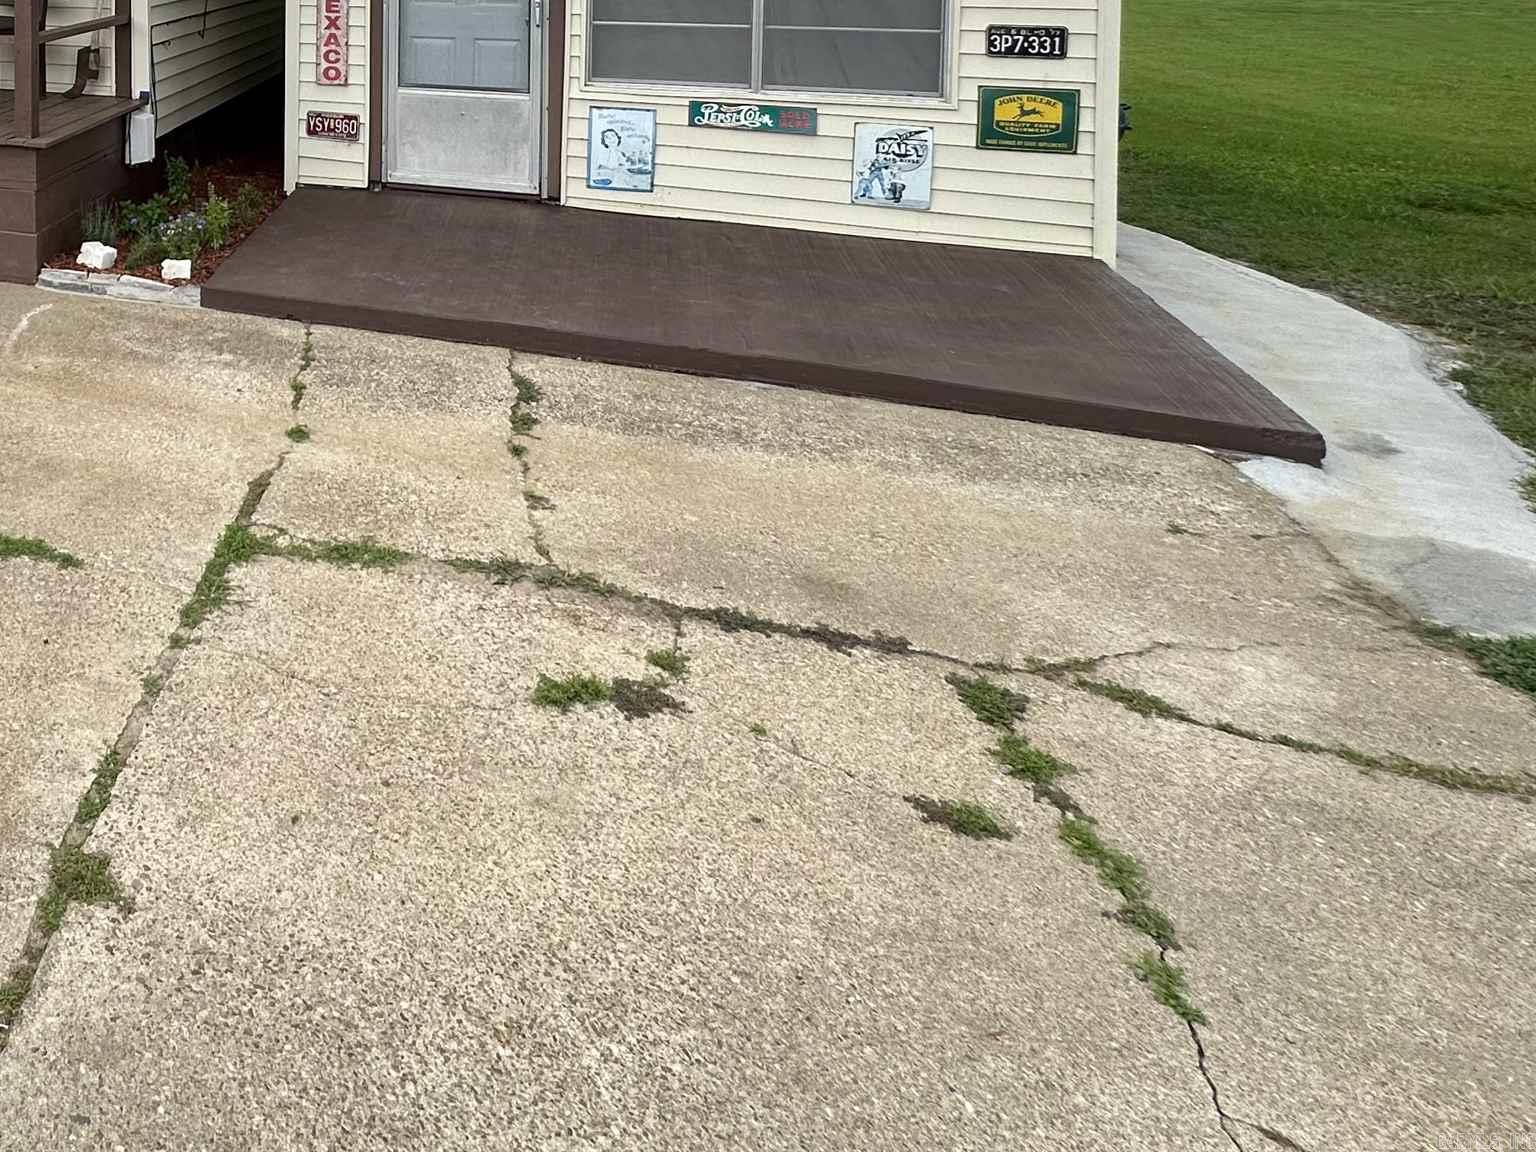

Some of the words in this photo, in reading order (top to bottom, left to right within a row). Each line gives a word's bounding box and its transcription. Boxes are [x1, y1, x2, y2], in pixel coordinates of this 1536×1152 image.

[997, 95, 1023, 106] JOHN
[1026, 95, 1058, 109] DEERE
[335, 118, 357, 135] 960
[876, 140, 929, 157] DAISY
